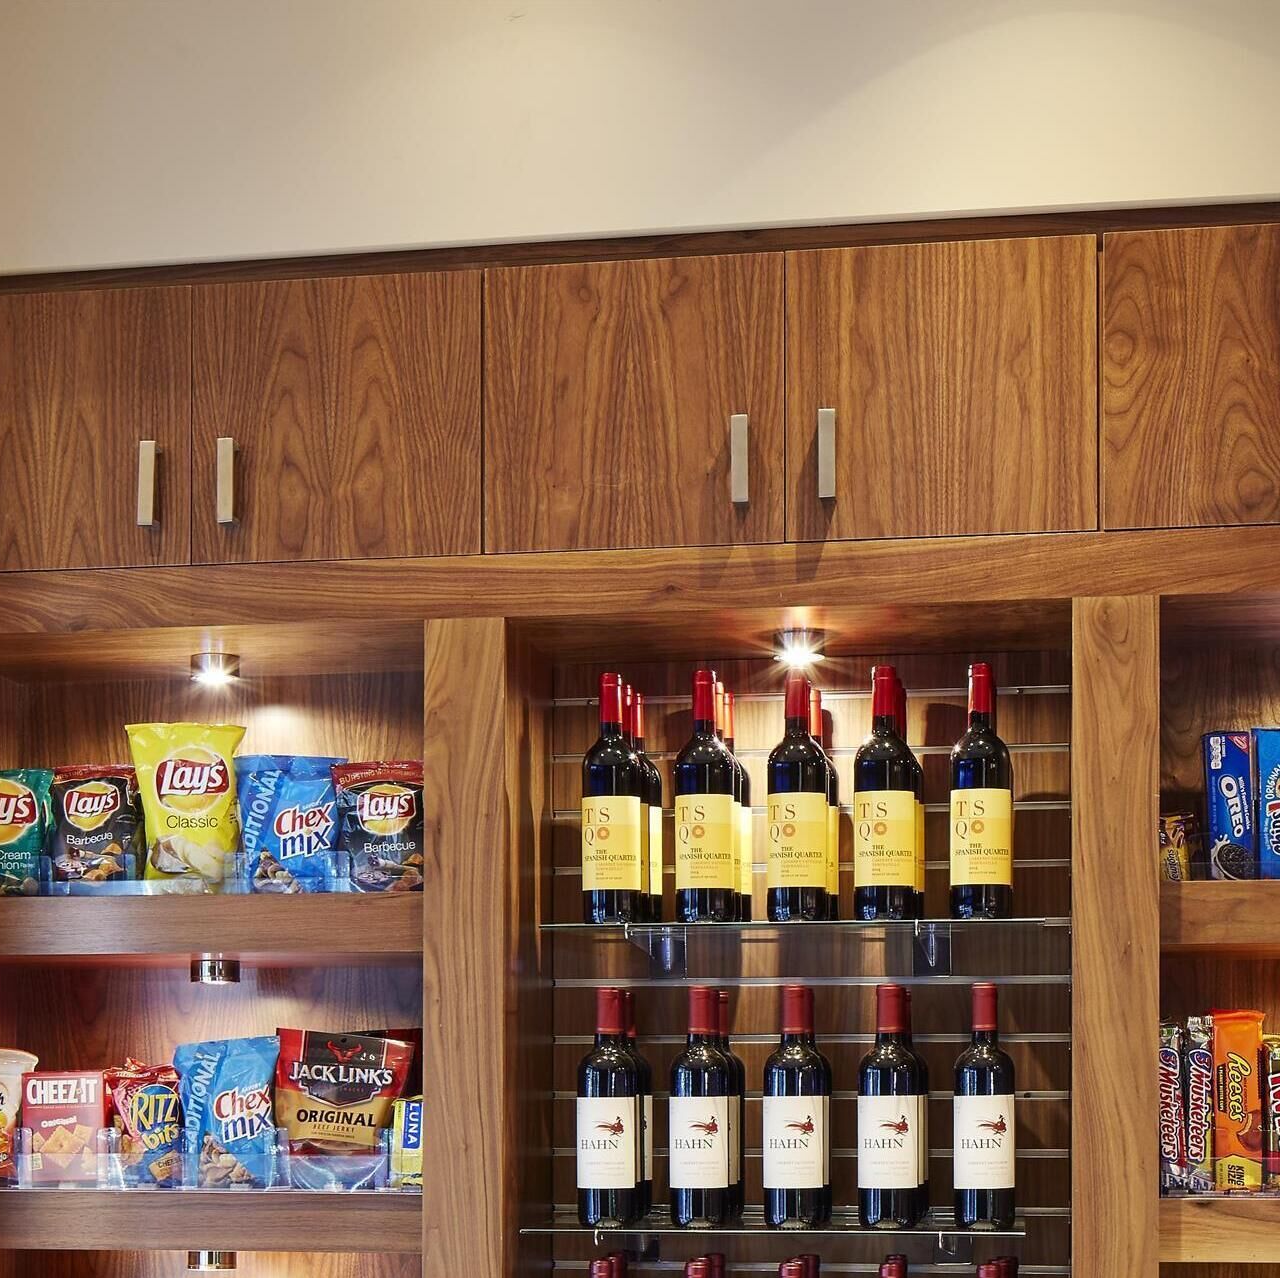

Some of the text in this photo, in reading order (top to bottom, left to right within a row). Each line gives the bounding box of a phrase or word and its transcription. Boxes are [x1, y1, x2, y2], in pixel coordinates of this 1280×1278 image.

[160, 761, 227, 795] Lay's
[68, 790, 115, 817] Lay's
[363, 793, 410, 821] Lay's
[770, 804, 795, 821] T S
[859, 801, 887, 818] T S
[956, 800, 984, 816] T S
[1220, 774, 1244, 838] OREO
[166, 814, 219, 829] Classic
[275, 802, 334, 835] Chex
[585, 807, 610, 823] T S
[679, 805, 705, 822] T S
[66, 832, 113, 845] Barbecue
[585, 827, 594, 845] Q
[679, 825, 689, 844] Q
[770, 824, 779, 842] Q
[859, 822, 870, 841] Q
[956, 821, 967, 839] Q
[282, 825, 331, 859] mix
[364, 841, 416, 853] Barbecue
[289, 1062, 393, 1086] JACK LINK'S
[26, 1077, 98, 1105] CHEEZ-IT
[1228, 1053, 1252, 1122] Reese's
[215, 1083, 270, 1120] Chex
[131, 1092, 179, 1131] RITZ
[296, 1109, 376, 1128] ORIGINAL
[1189, 1067, 1211, 1164] Musketeers
[223, 1108, 272, 1142] mix
[408, 1102, 419, 1144] LUNA
[141, 1122, 180, 1150] bits
[581, 1139, 618, 1150] HAHN
[675, 1139, 713, 1149] HAHN
[769, 1138, 809, 1149] HAHN
[864, 1138, 904, 1149] HAHN
[961, 1138, 1002, 1149] HAHN
[1237, 1165, 1245, 1186] KING
